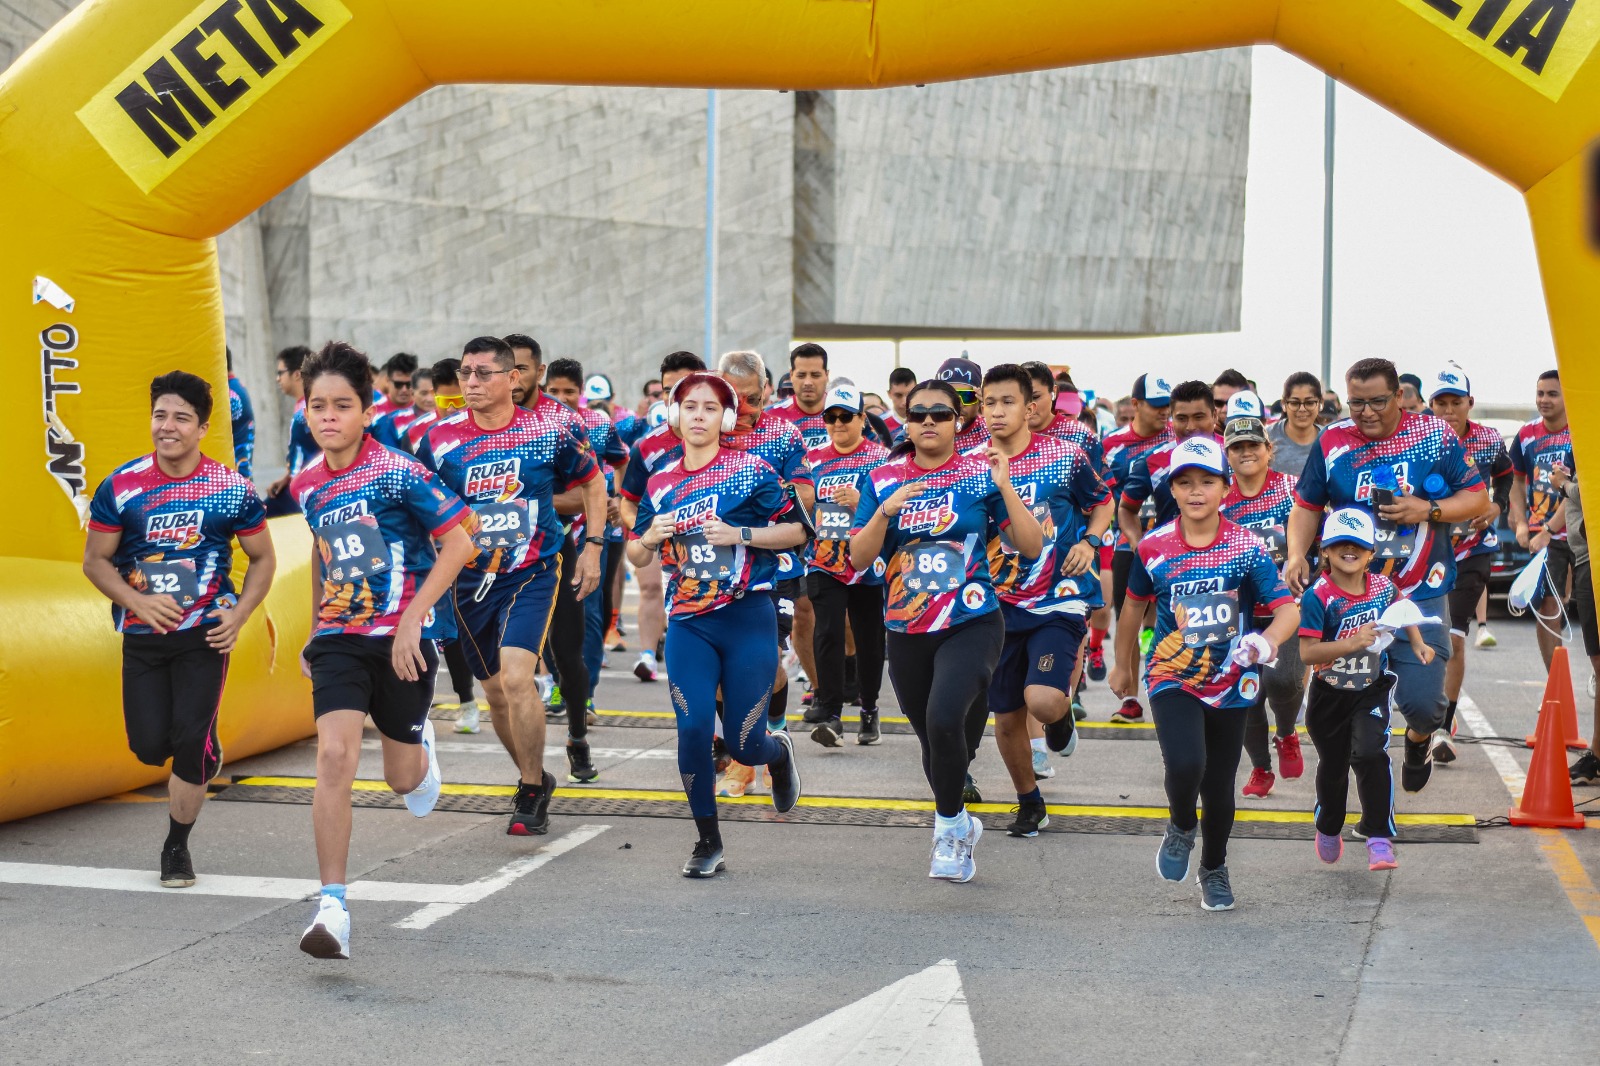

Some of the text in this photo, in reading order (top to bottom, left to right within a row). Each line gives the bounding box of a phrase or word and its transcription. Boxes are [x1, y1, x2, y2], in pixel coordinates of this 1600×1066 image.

[114, 0, 325, 159] META
[470, 460, 516, 482] RUBA
[820, 474, 856, 488] RUBA
[1360, 464, 1405, 486] RA
[467, 474, 516, 495] RACE
[478, 490, 501, 499] 2024
[322, 502, 363, 527] RUBA
[676, 496, 713, 523] RUBA
[901, 494, 949, 516] RUBA
[150, 511, 199, 532] RUBA
[481, 511, 521, 532] 228
[675, 509, 714, 534] RACE
[822, 512, 850, 528] 232
[900, 506, 950, 528] RACE
[911, 522, 936, 532] 2024
[333, 534, 365, 561] 18
[690, 544, 716, 564] 83
[918, 552, 948, 574] 86
[150, 573, 181, 593] 32
[1174, 578, 1219, 597] RUBA
[1187, 603, 1232, 628] 210
[1342, 610, 1376, 630] RUBA
[1331, 655, 1371, 675] 211
